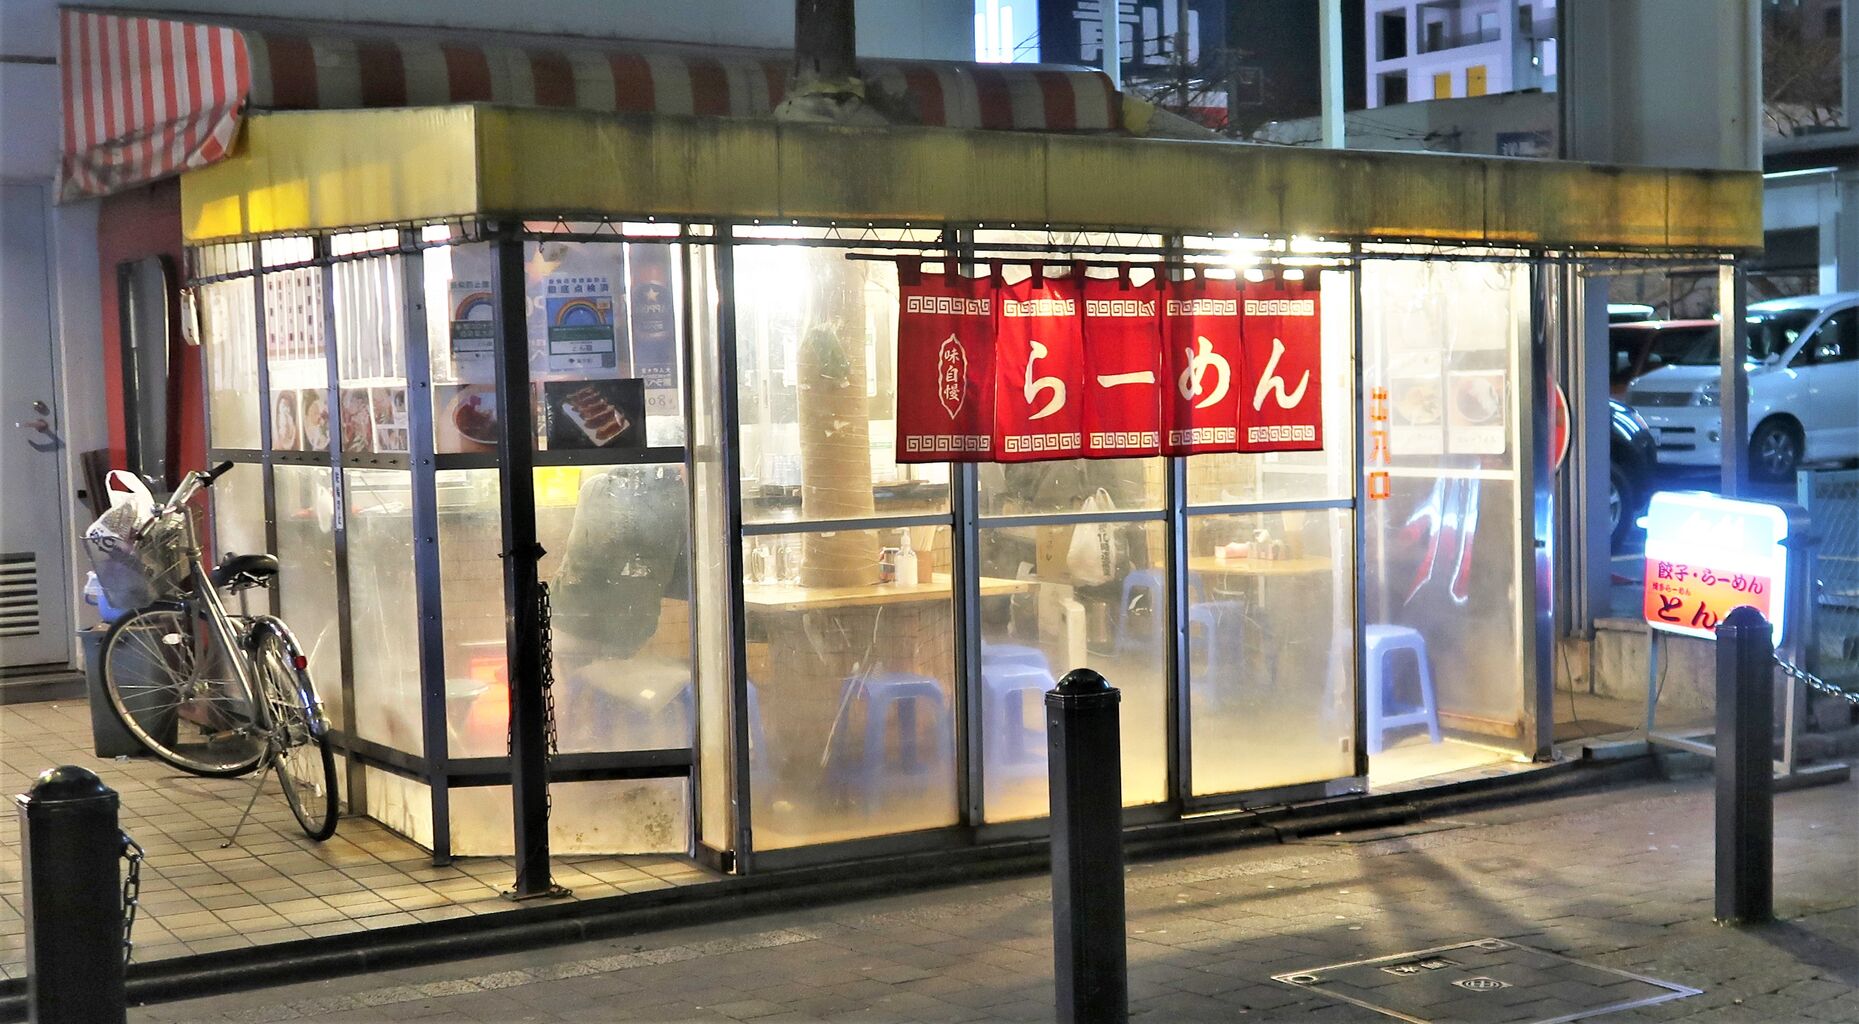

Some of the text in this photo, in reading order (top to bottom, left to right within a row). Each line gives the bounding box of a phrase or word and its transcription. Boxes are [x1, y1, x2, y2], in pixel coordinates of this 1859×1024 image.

[943, 348, 960, 402] 味自慢
[1024, 336, 1311, 420] らーめん
[1367, 385, 1391, 501] 出入口
[1658, 561, 1764, 595] 餃子・らーめん
[1657, 594, 1718, 629] とん
